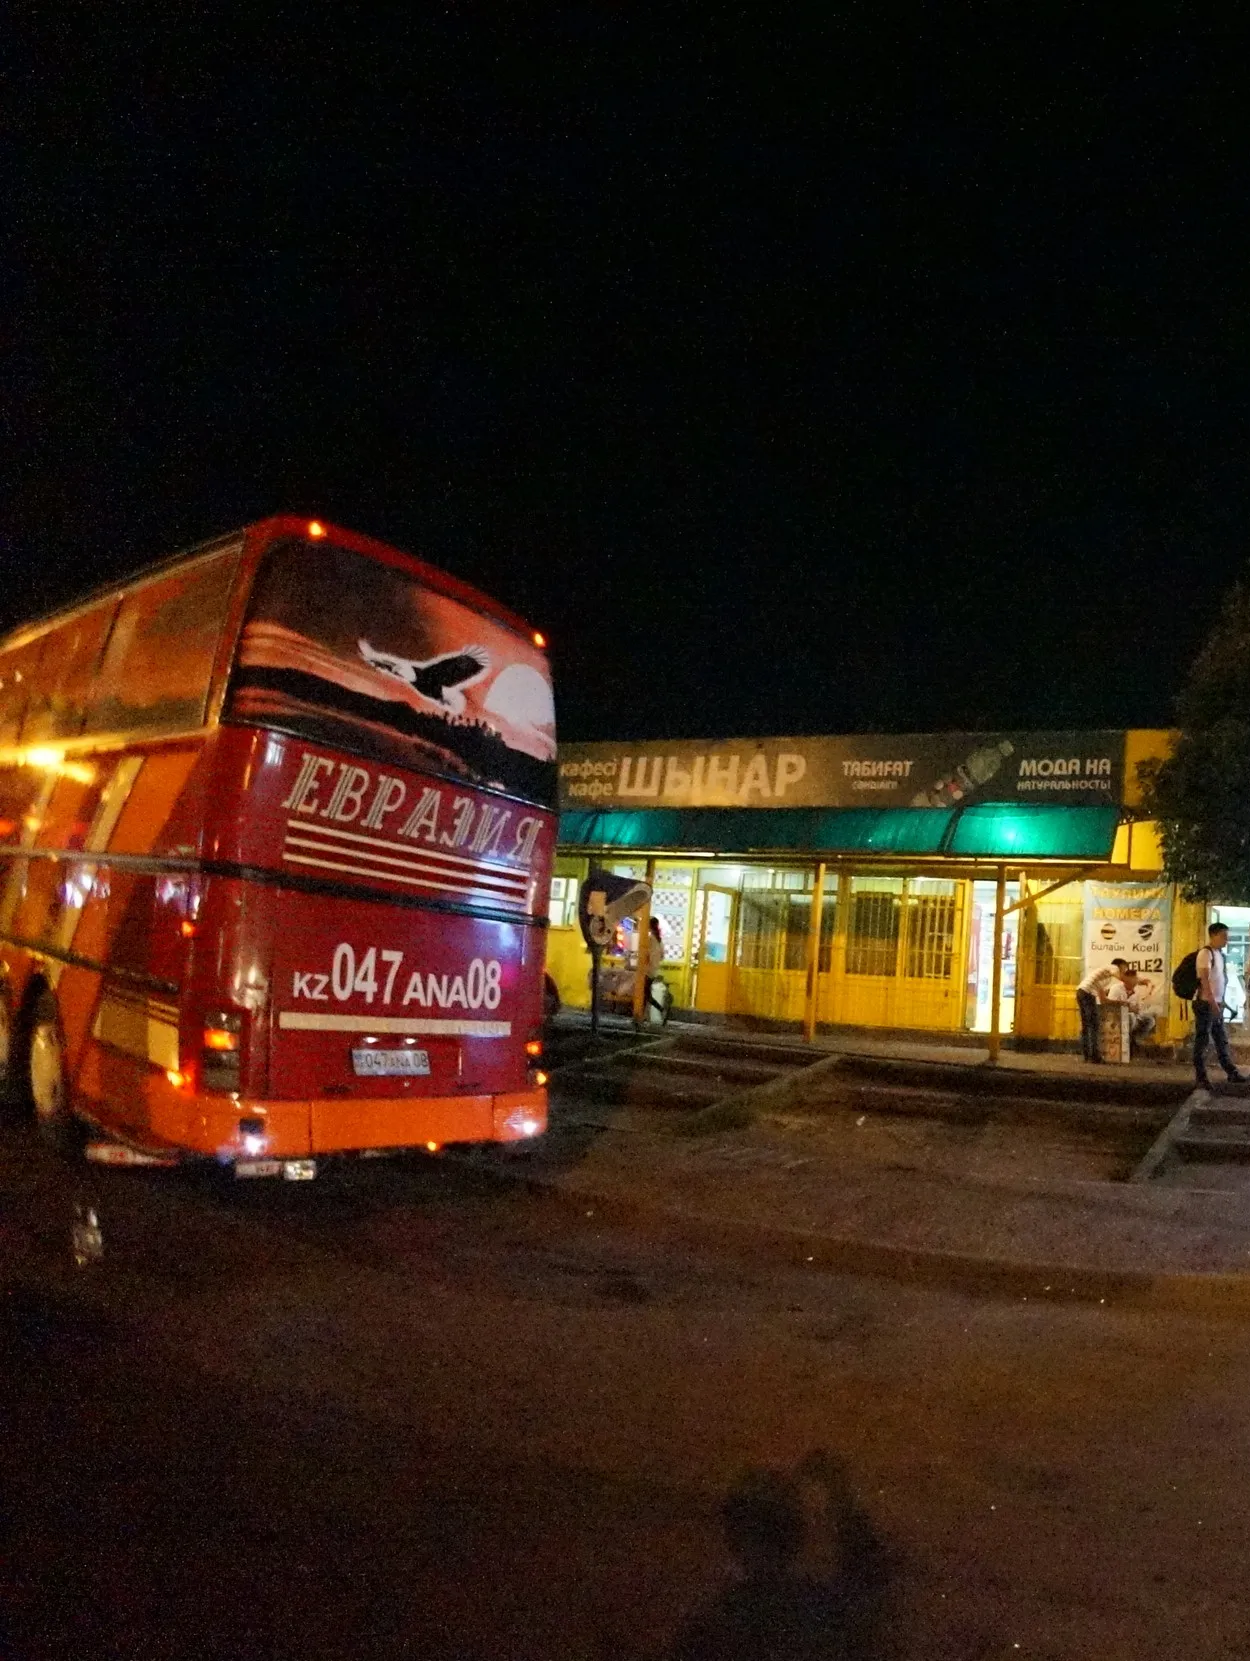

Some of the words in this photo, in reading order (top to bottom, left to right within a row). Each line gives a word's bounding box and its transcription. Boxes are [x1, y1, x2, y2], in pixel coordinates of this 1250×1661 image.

[1019, 759, 1080, 776] МОДА
[1085, 759, 1111, 775] НА
[617, 754, 807, 798] ШЫНАР
[568, 779, 613, 800] кафе
[280, 753, 544, 865] ЕВРАЗИЯ
[1094, 907, 1161, 920] НОМЕРА
[1091, 941, 1125, 951] Билайн
[1132, 943, 1159, 952] Kcell
[1127, 958, 1163, 973] TELE2
